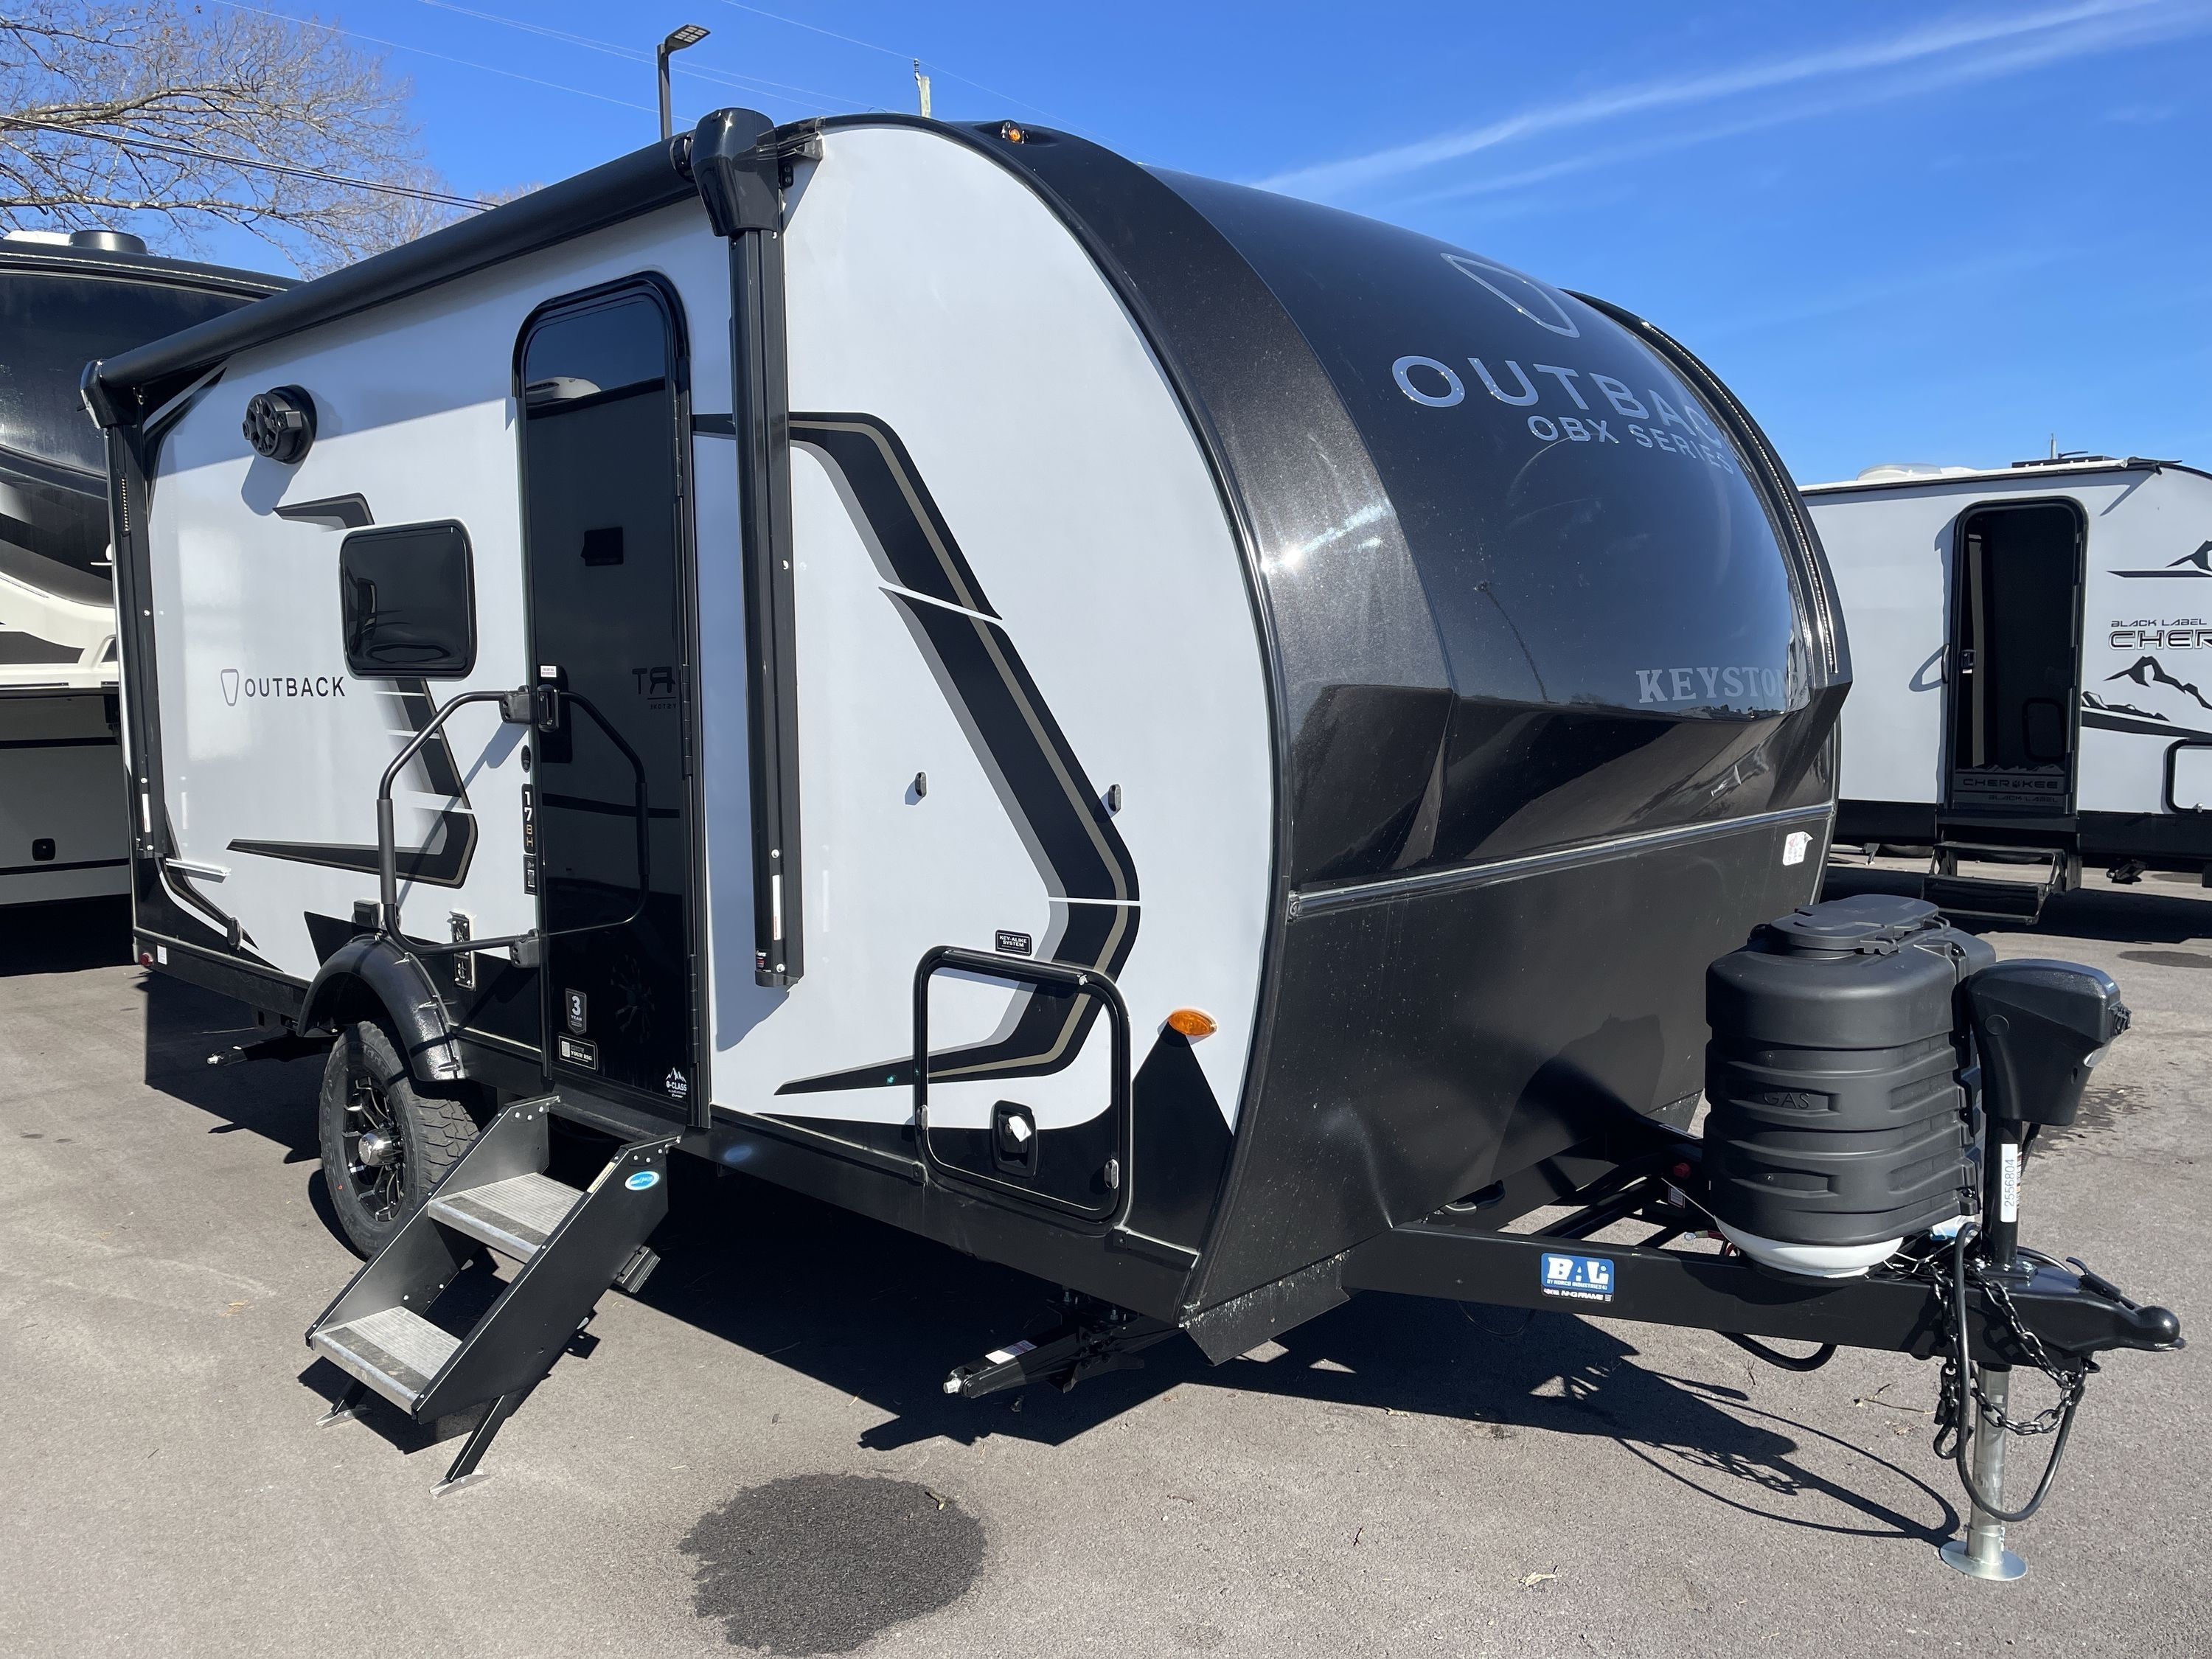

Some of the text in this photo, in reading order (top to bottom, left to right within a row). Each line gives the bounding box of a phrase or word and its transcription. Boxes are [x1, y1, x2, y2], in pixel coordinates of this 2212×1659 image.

[1527, 415, 1733, 476] OBX SERIES
[2111, 618, 2208, 627] BLACK LABEL
[245, 677, 345, 698] OUTBACK
[1000, 936, 1026, 944] KEY-ALIKE
[571, 995, 581, 1016] 3
[2004, 1158, 2015, 1207] 2556804
[1572, 1281, 1602, 1290] INDUSTRIES
